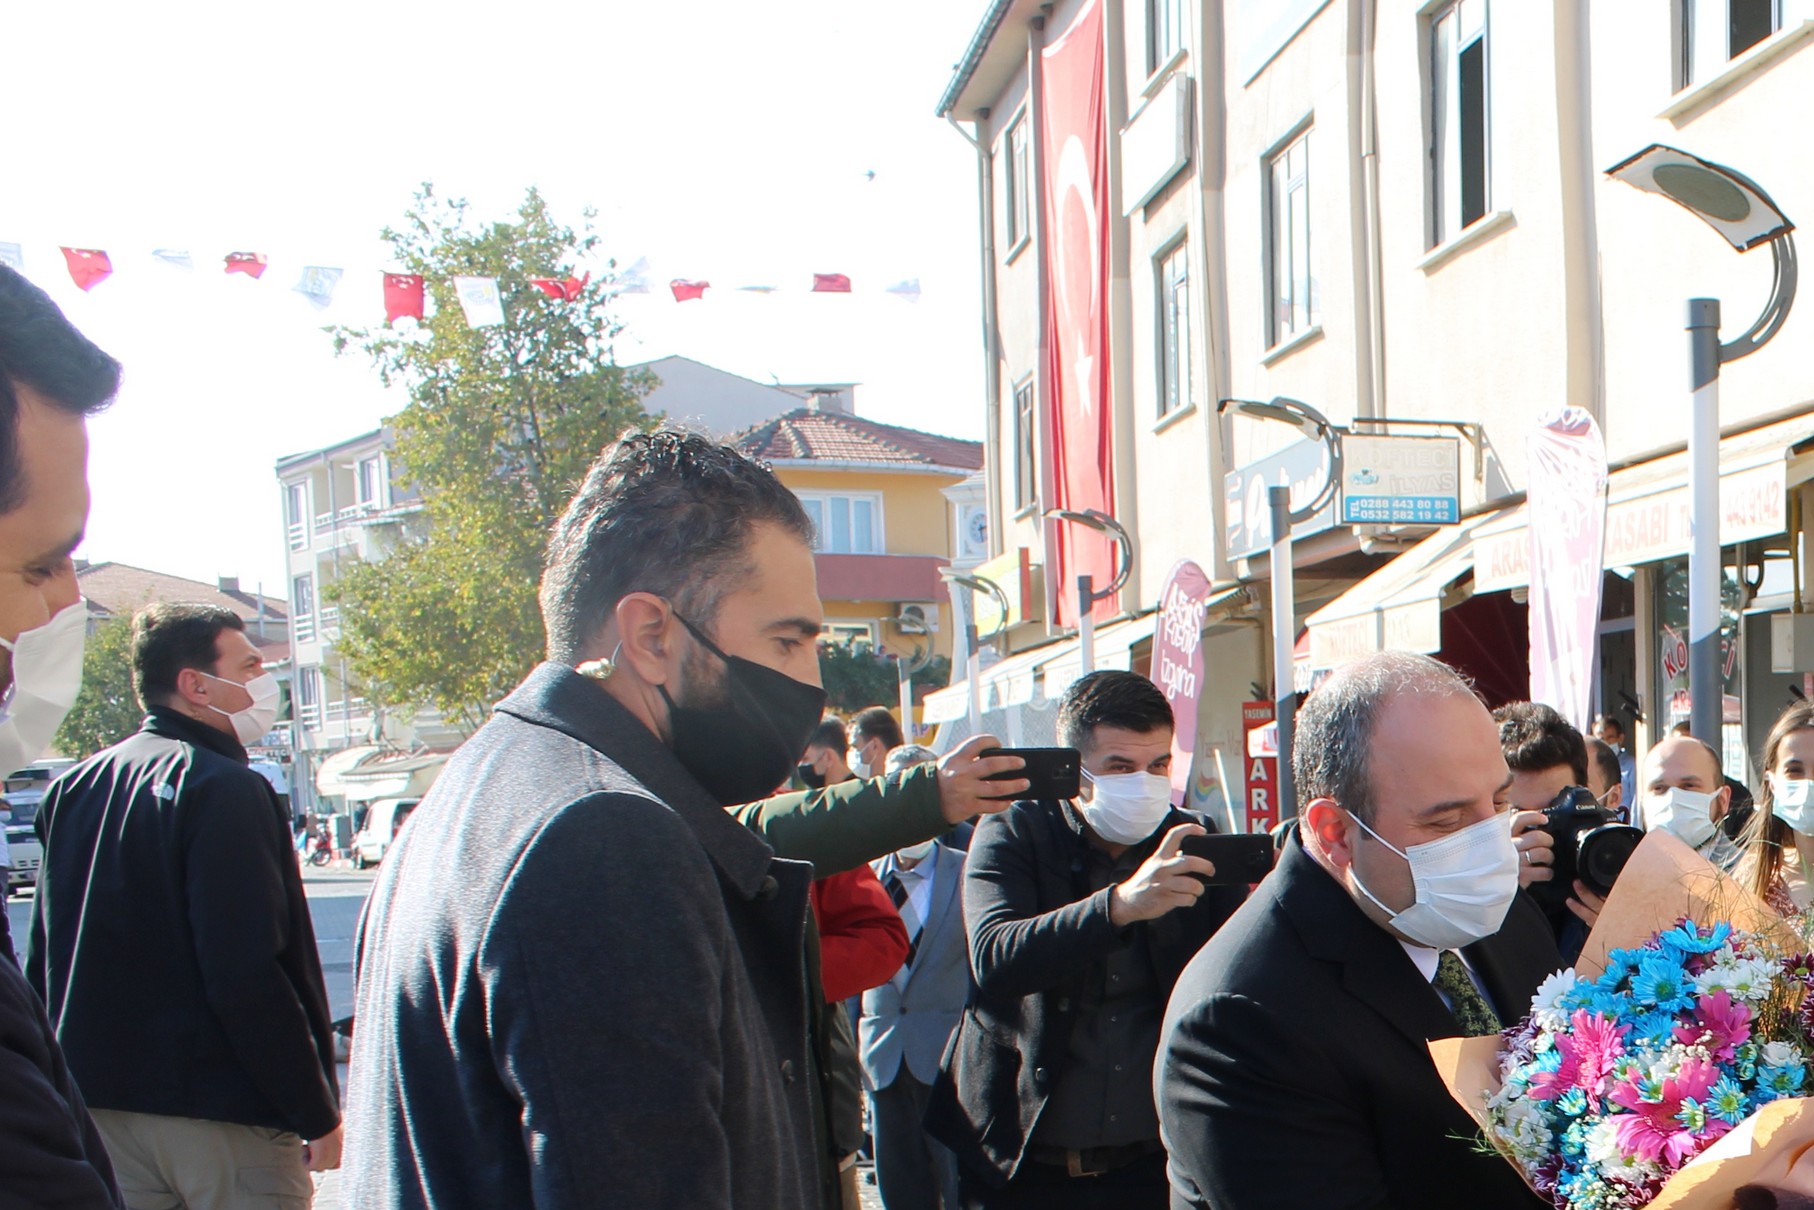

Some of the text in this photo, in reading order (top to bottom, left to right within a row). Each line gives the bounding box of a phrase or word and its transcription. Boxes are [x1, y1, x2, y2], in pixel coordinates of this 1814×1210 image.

[1360, 499, 1449, 509] 0288 443 80 88
[1360, 510, 1449, 519] 0532 582 19 42
[1244, 706, 1272, 720] YASEMİN
[1250, 758, 1269, 834] ARK
